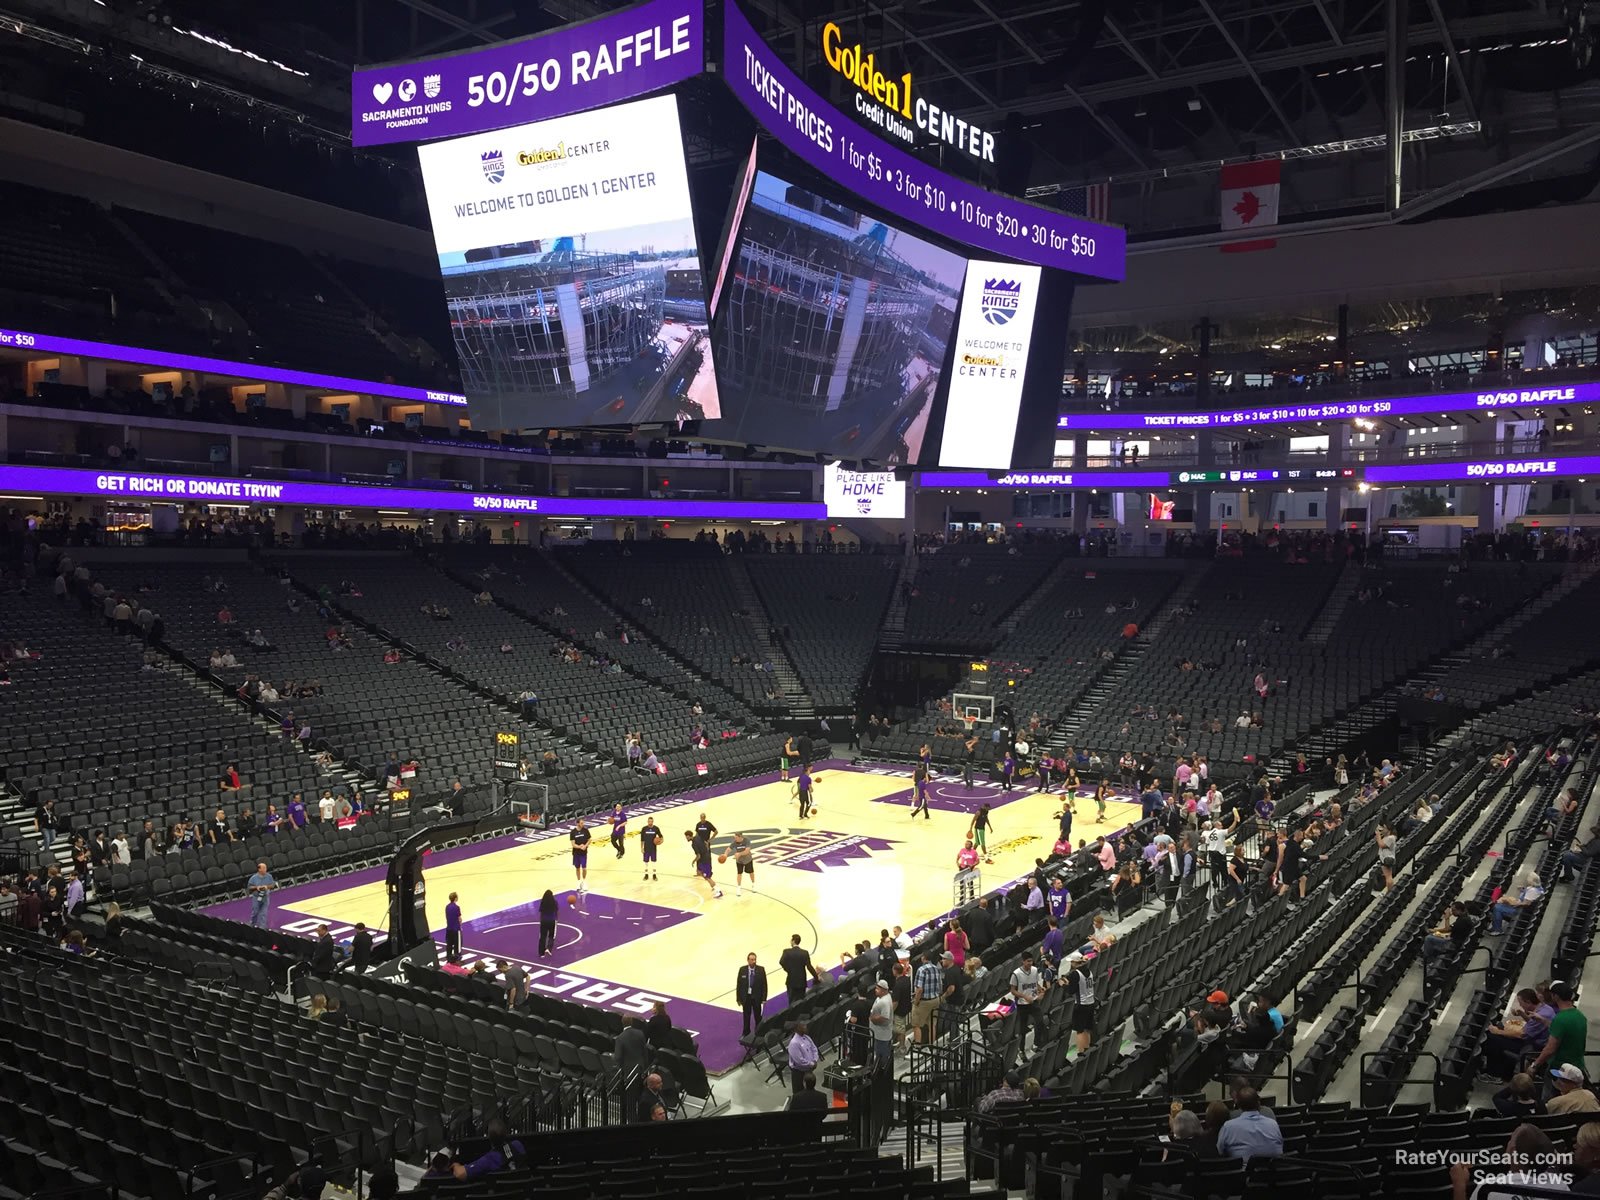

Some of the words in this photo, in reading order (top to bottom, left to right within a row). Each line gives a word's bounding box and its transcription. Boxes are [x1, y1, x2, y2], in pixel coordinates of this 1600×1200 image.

[467, 58, 561, 107] 50/50
[571, 15, 690, 85] RAFFLE
[362, 105, 422, 122] SACRAMENTO
[424, 101, 452, 114] KINGS
[856, 92, 884, 127] Credit
[886, 113, 914, 144] Union
[386, 117, 428, 128] FOUNDATION
[915, 97, 994, 162] CENTER
[567, 140, 610, 158] CENTER
[744, 44, 785, 114] TICKET
[787, 93, 833, 153] PRICES
[840, 136, 847, 160] 1
[849, 142, 865, 170] for
[867, 152, 882, 181] $5
[895, 169, 903, 192] 3
[905, 174, 922, 200] for
[924, 183, 946, 212] $10
[960, 200, 973, 222] 10
[976, 206, 993, 229] for
[996, 212, 1019, 238] $20
[1032, 225, 1047, 245] 30
[1050, 229, 1068, 250] for
[1071, 233, 1095, 257] $50
[483, 163, 505, 172] KINGS
[454, 196, 516, 218] WELCOME
[517, 192, 534, 208] TO
[537, 184, 589, 206] GOLDEN
[592, 182, 598, 195] 1
[601, 172, 656, 194] CENTER
[981, 296, 1018, 308] KINGS
[15, 333, 35, 345] $50
[965, 339, 1009, 350] WELCOME
[1012, 343, 1022, 351] TO
[959, 365, 1017, 379] CENTER
[426, 391, 449, 401] TICKET
[1477, 392, 1517, 406] 50/50
[1521, 389, 1575, 403] RAFFLE
[1144, 416, 1176, 425] TICKET
[1177, 415, 1209, 424] PRICES
[1220, 414, 1231, 423] for
[1232, 413, 1244, 423] $5
[1252, 412, 1258, 420] 3
[1259, 411, 1271, 420] for
[1272, 410, 1288, 419] $10
[1297, 408, 1306, 417] 10
[1308, 408, 1320, 416] for
[1322, 406, 1338, 416] $20
[1346, 405, 1357, 413] 30
[1359, 404, 1372, 413] for
[1373, 402, 1391, 412] $50
[1467, 464, 1504, 476] 50/50
[1506, 461, 1556, 474] RAFFLE
[836, 474, 868, 482] PLACE
[870, 473, 892, 482] LIKE
[1031, 475, 1073, 484] RAFFLE
[96, 475, 126, 490] GET
[129, 477, 163, 492] RICH
[166, 479, 186, 493] OR
[189, 481, 241, 496] DONATE
[843, 483, 885, 495] HOME
[473, 496, 501, 509] 50/50
[503, 498, 538, 510] RAFFLE
